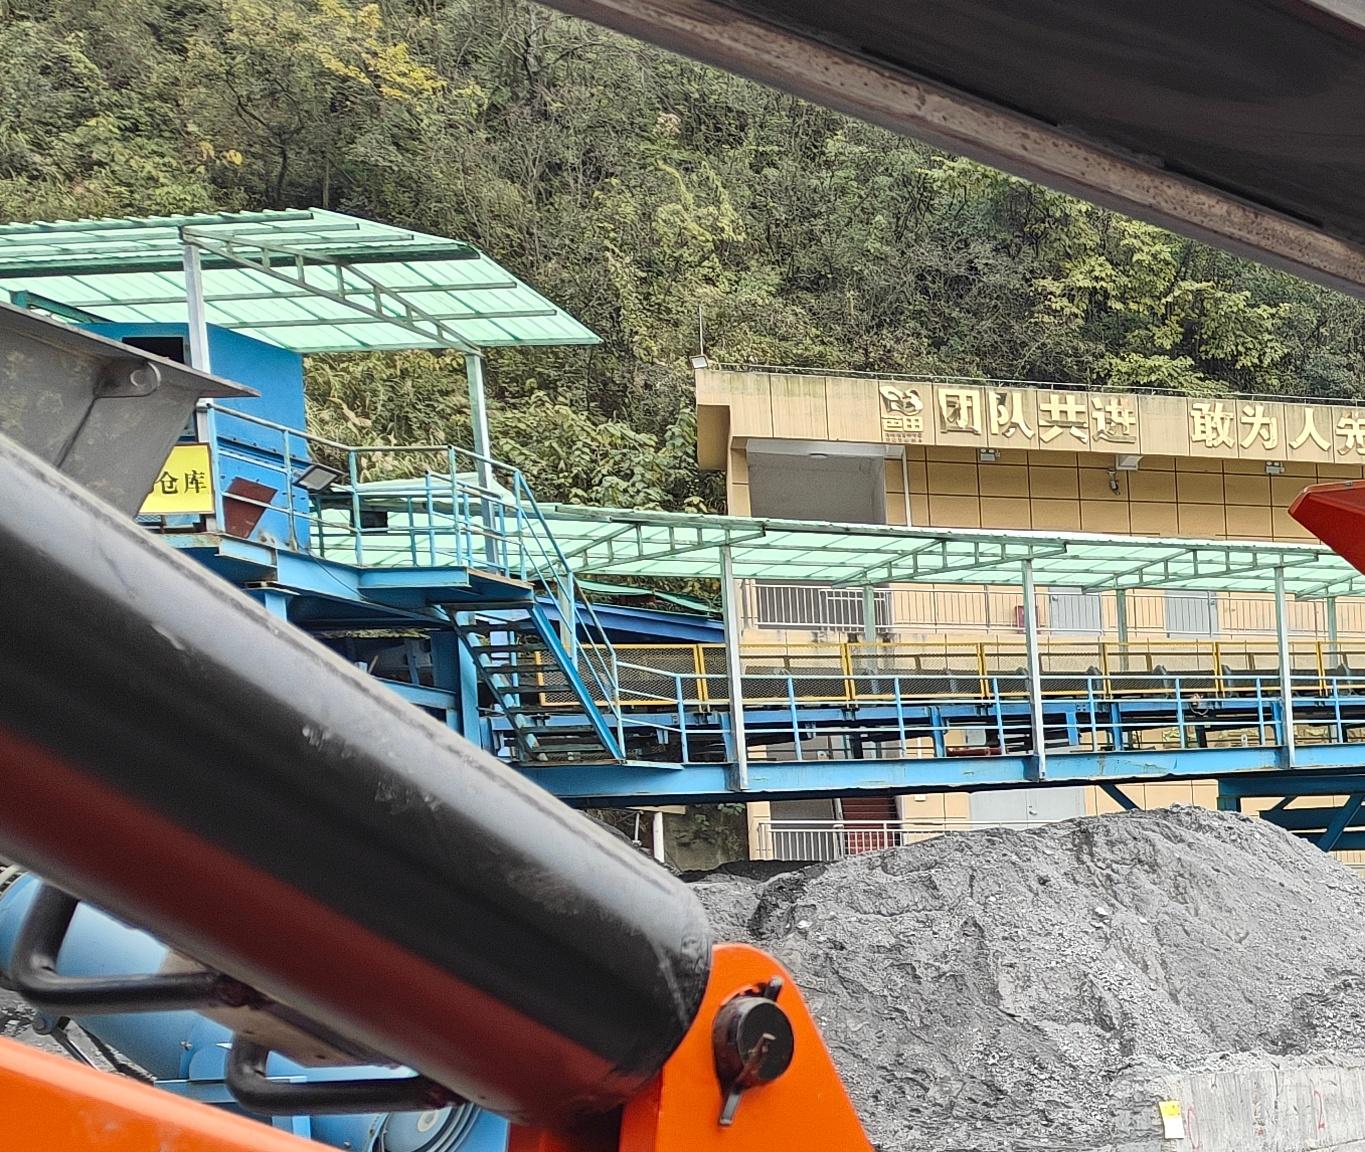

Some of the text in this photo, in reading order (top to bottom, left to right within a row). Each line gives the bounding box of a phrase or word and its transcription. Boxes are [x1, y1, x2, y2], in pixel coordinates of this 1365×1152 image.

[937, 388, 1138, 444] 团队共进
[157, 470, 207, 494] 仓库
